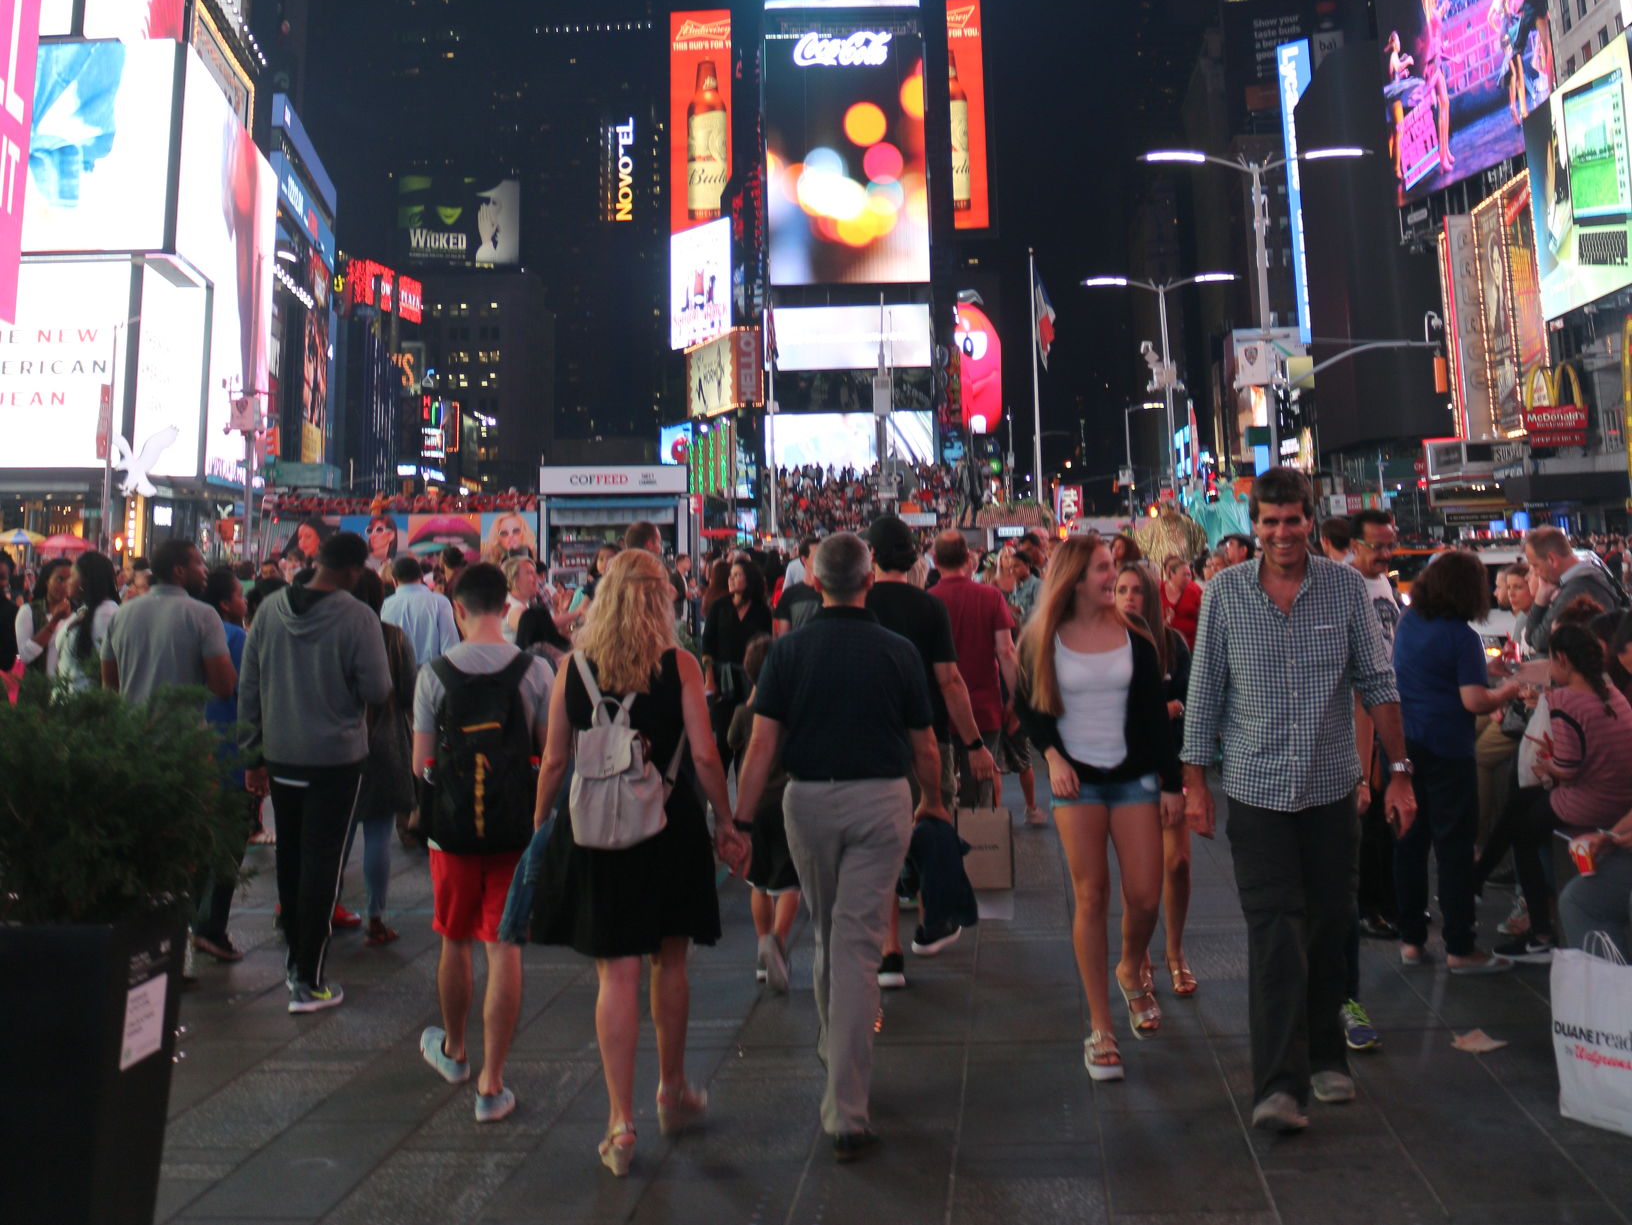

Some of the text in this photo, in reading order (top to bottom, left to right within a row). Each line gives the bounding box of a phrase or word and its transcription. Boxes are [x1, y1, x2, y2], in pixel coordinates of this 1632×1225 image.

[710, 40, 724, 50] FOR
[793, 31, 892, 67] Coca-Cola
[37, 328, 98, 344] NEW
[1527, 411, 1586, 423] McDonald's
[569, 473, 628, 485] COFFEED
[1554, 1020, 1593, 1044] DUANE
